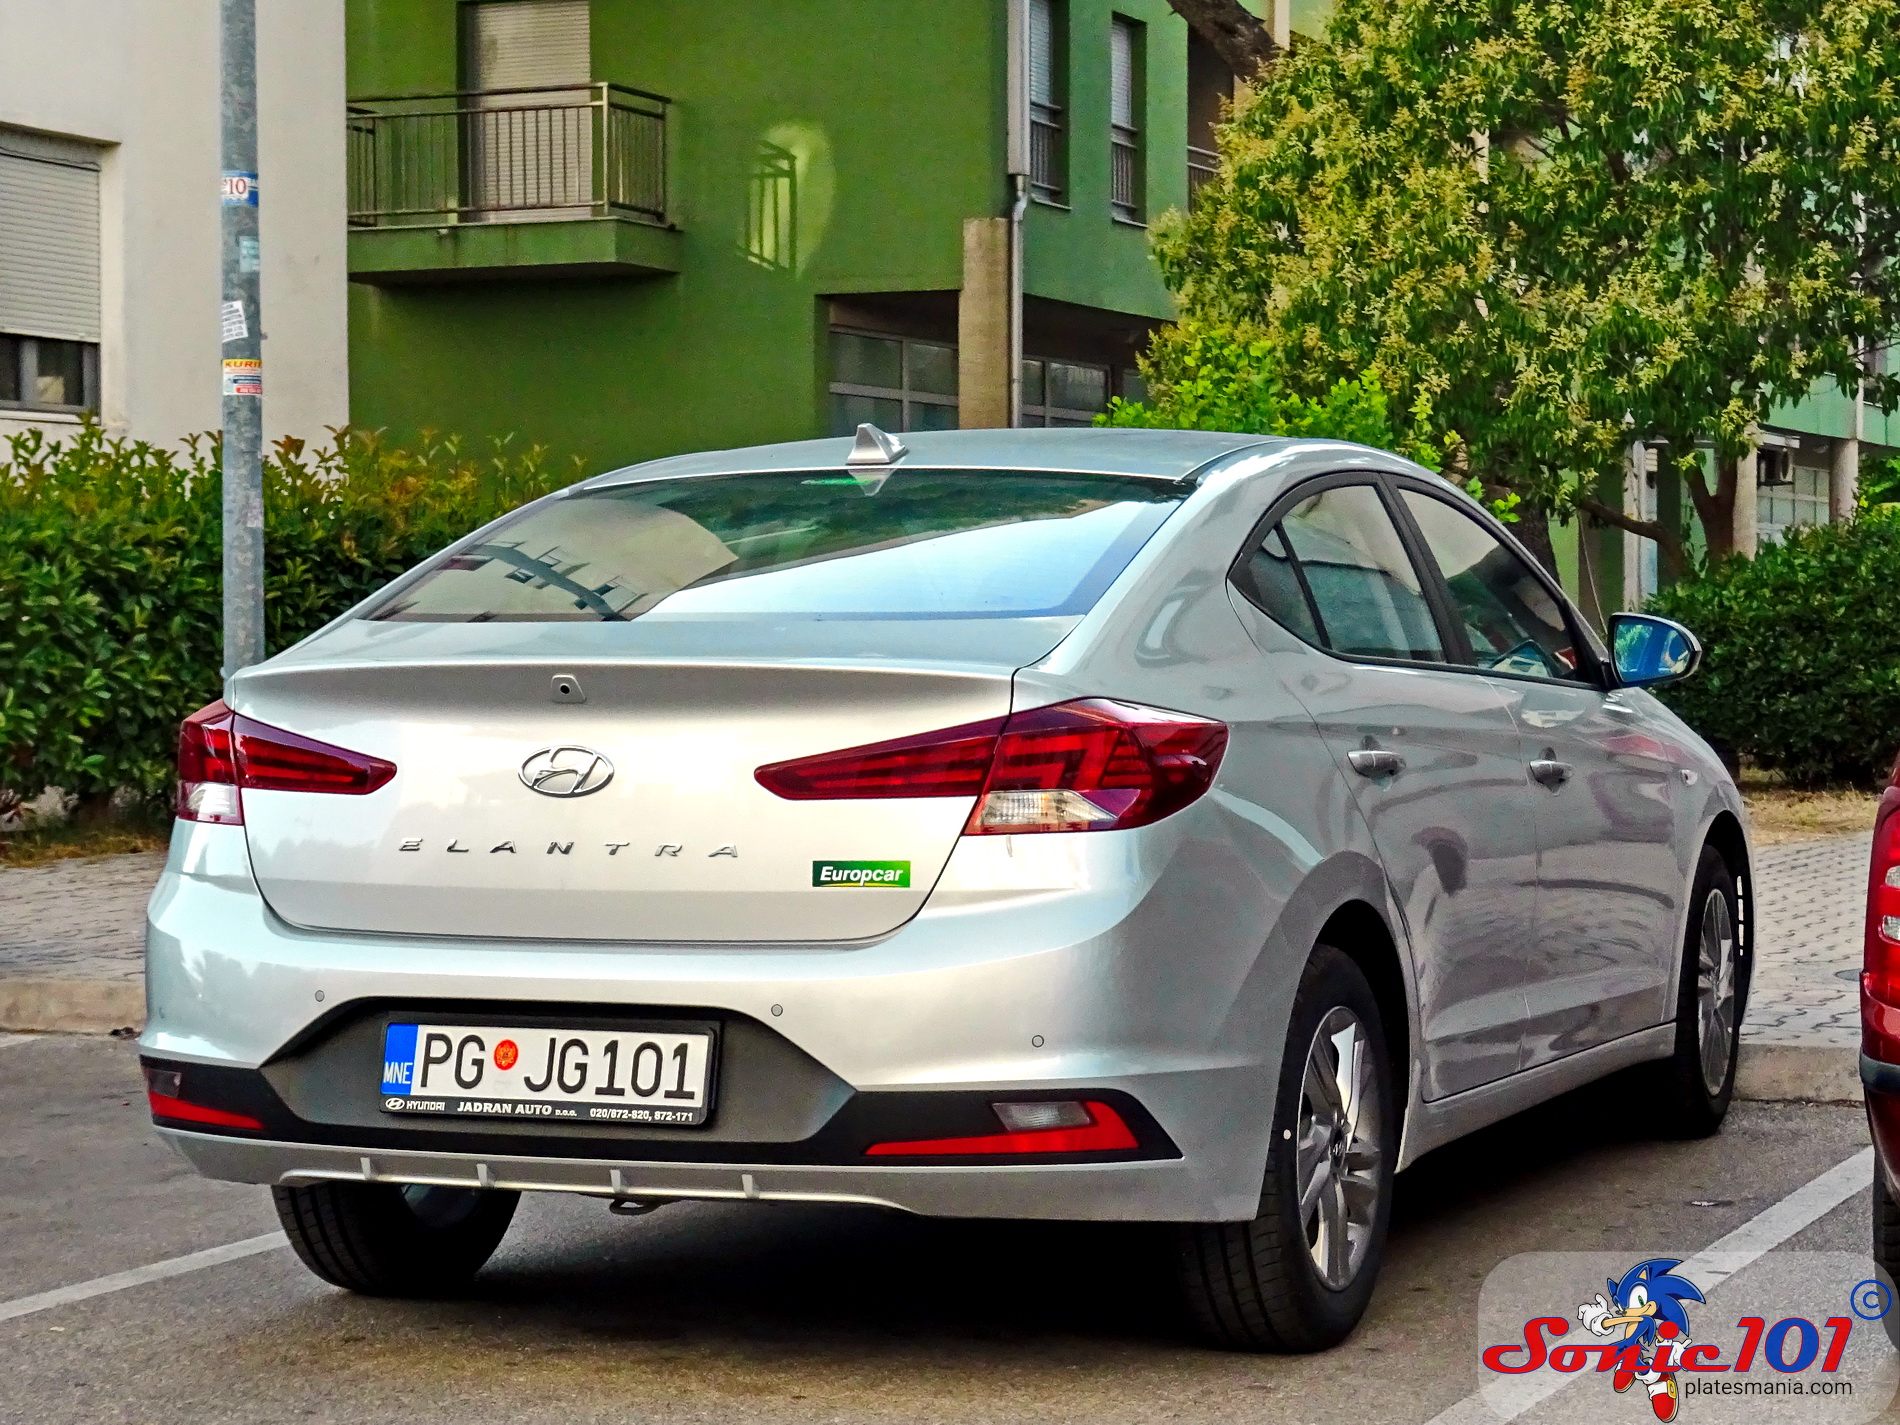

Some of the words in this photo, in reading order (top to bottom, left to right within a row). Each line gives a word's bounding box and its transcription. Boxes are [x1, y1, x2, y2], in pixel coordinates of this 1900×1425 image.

[399, 837, 739, 859] ELANTRA
[820, 866, 903, 886] Europcar
[383, 1061, 413, 1084] MNE
[420, 1033, 486, 1090] PG
[523, 1037, 696, 1100] JG101
[406, 1100, 446, 1111] HYUNDAI
[457, 1101, 512, 1114] JADRAN
[514, 1103, 552, 1115] AUTO
[654, 1111, 693, 1122] 872-171
